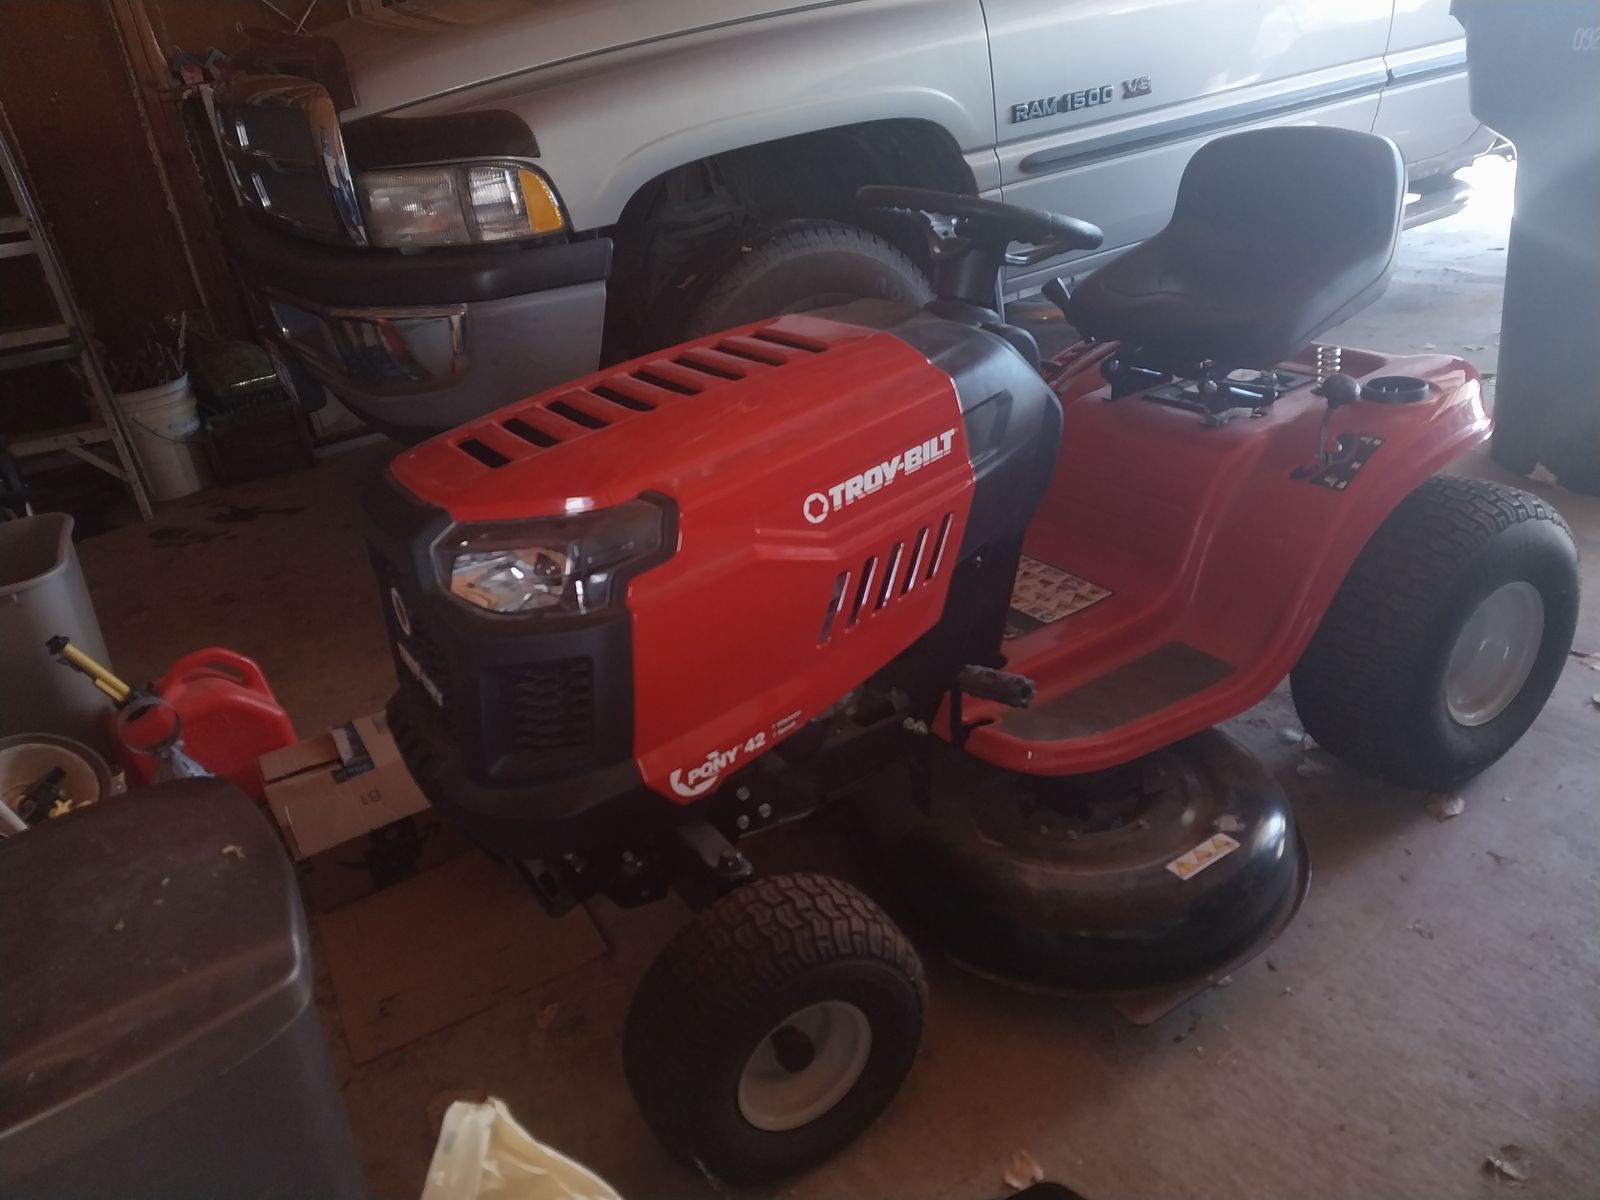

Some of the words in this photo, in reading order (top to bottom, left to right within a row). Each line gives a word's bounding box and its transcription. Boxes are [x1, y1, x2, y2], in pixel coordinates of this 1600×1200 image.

[1009, 96, 1058, 123] RAM
[1060, 85, 1114, 113] 1500
[828, 428, 955, 511] TROY-BILT
[687, 746, 738, 785] PONY
[744, 731, 766, 752] 42
